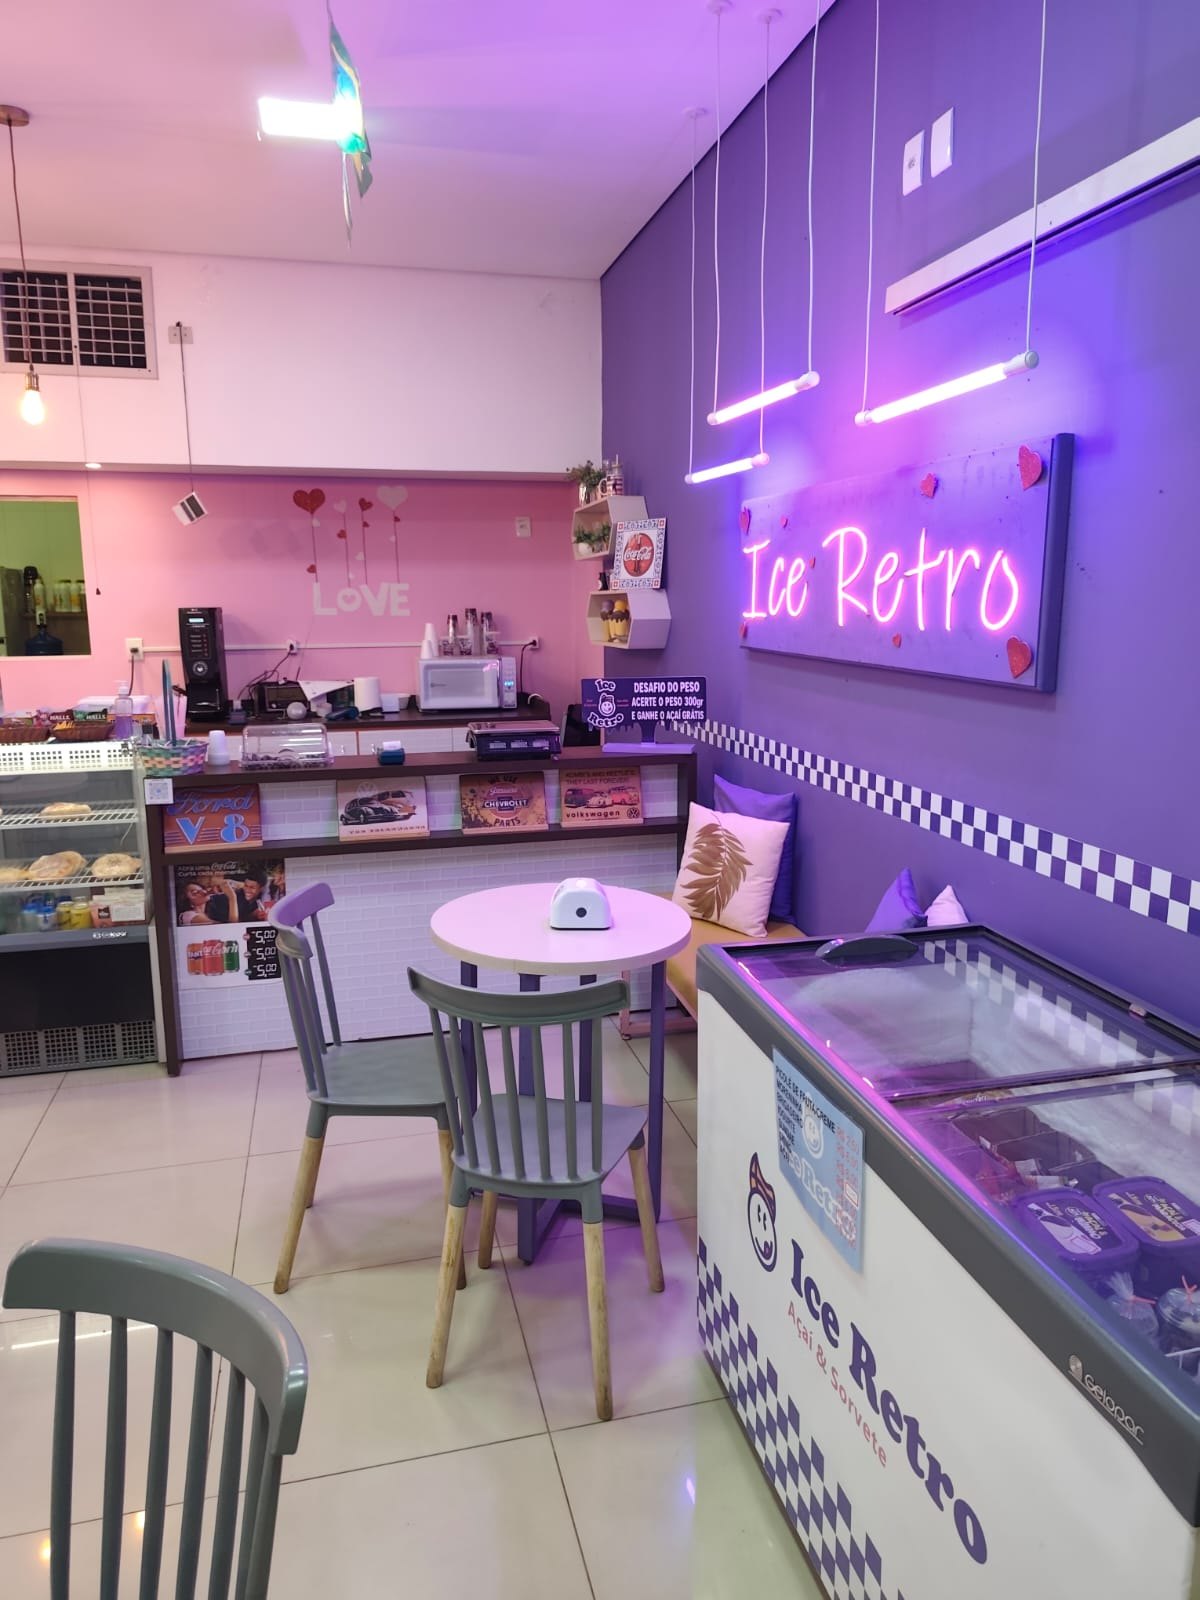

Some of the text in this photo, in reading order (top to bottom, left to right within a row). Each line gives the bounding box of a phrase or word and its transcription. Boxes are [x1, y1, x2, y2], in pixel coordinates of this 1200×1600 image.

[742, 526, 1019, 631] Ice Retro
[595, 679, 616, 692] Ice
[634, 681, 700, 693] DESAFIO DO PESO
[632, 697, 657, 707] ACERTE
[658, 697, 664, 706] O
[665, 697, 683, 706] PESO
[684, 696, 703, 708] 300gr
[587, 712, 624, 727] Retro
[631, 709, 704, 721] E GANHE O AÇAÍ GRÁTIS
[167, 790, 256, 815] Ford
[484, 799, 528, 808] CHEVROLET
[566, 810, 620, 818] volkswagen
[494, 816, 521, 827] PARTS
[176, 813, 250, 845] V 8
[791, 1238, 988, 1565] Ice Retro
[816, 1344, 827, 1375] &
[831, 1366, 887, 1468] Sorvete
[1084, 1374, 1144, 1437] Gelopar
